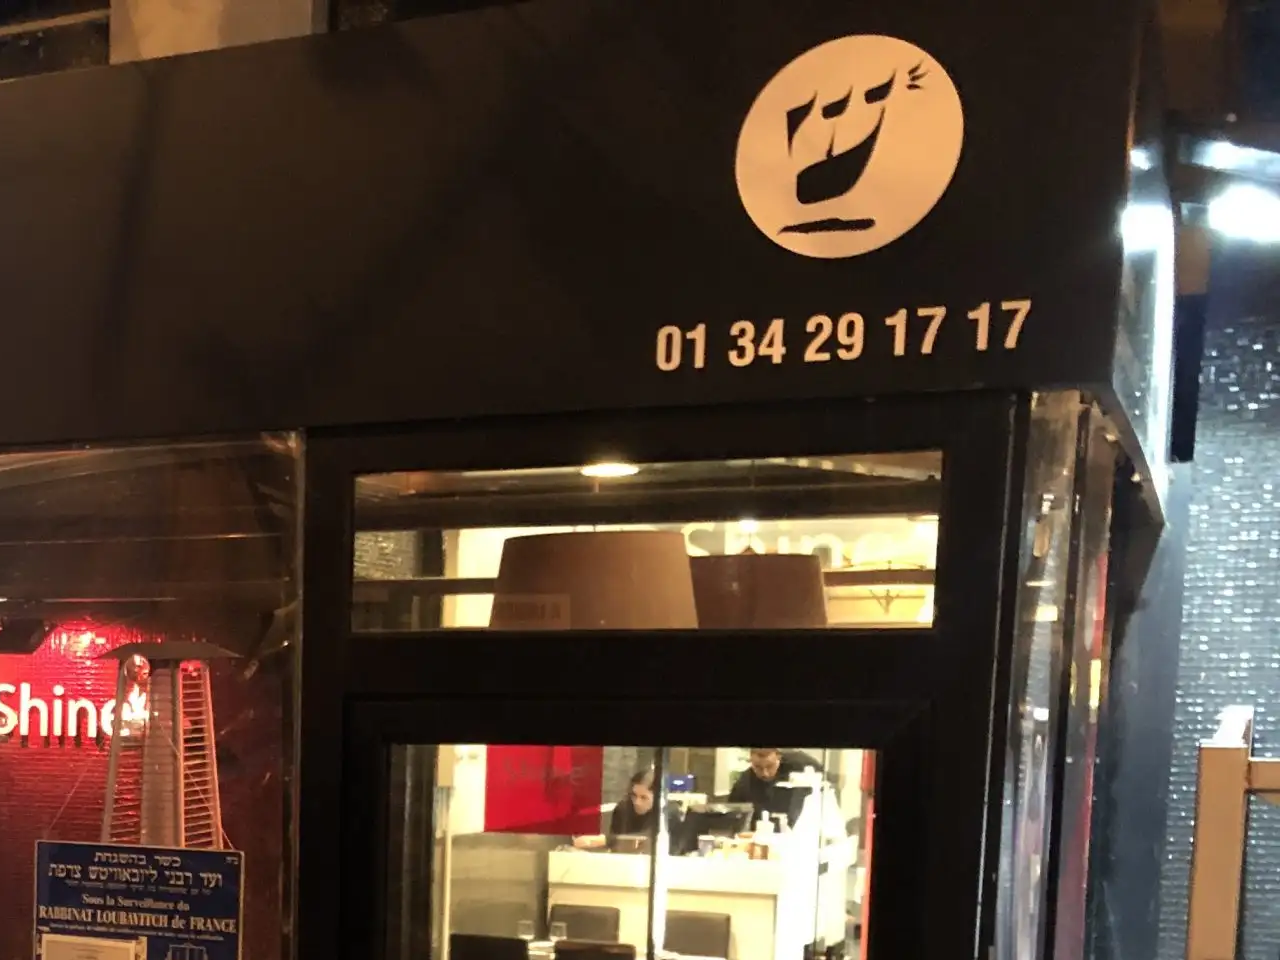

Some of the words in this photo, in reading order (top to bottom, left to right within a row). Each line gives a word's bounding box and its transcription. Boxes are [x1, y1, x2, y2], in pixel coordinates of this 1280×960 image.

[655, 322, 707, 372] 01
[728, 317, 787, 368] 34
[804, 312, 865, 363] 29
[885, 306, 947, 356] 17
[967, 299, 1032, 351] 17
[81, 893, 104, 905] Sous
[38, 905, 94, 922] RABBINAT
[96, 909, 168, 928] LOUBAVITCH
[171, 914, 187, 930] de
[189, 916, 237, 934] FRANCE
